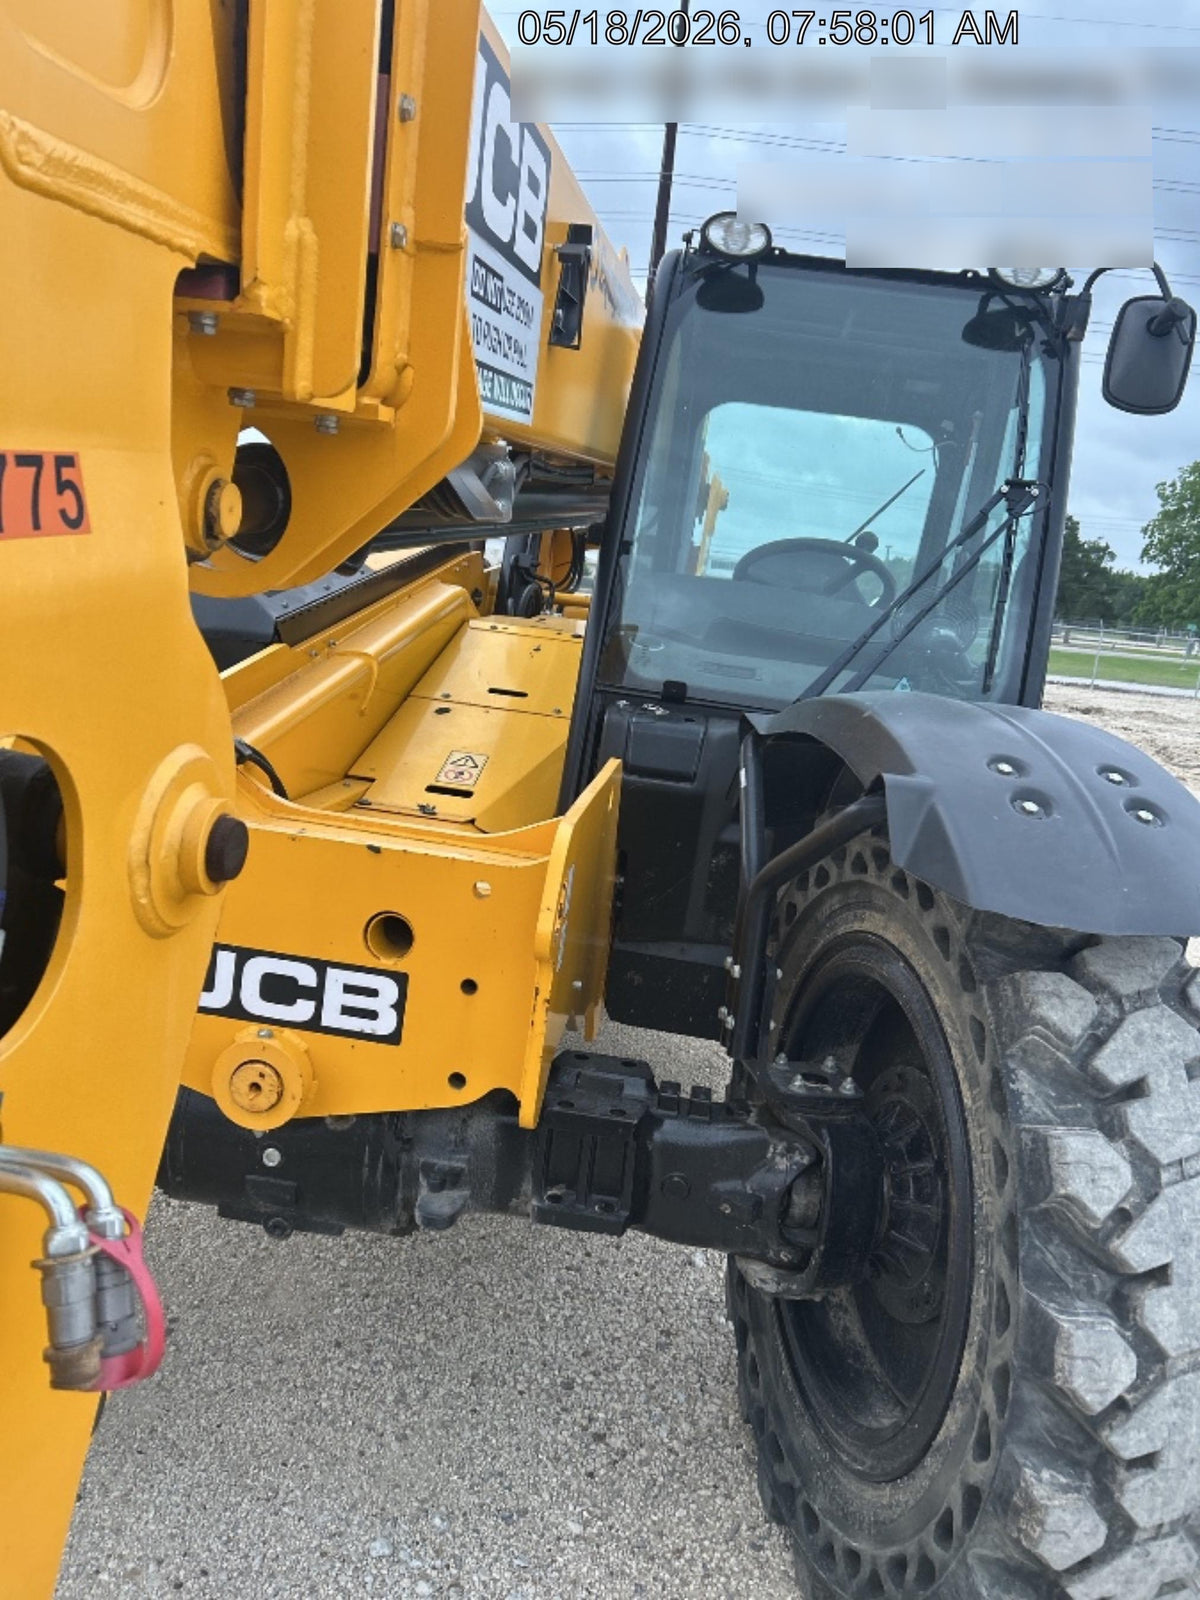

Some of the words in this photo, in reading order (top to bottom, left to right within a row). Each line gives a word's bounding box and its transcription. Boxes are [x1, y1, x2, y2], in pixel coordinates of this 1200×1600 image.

[473, 261, 486, 297] DO
[472, 313, 482, 346] TO
[199, 949, 399, 1036] JCB
